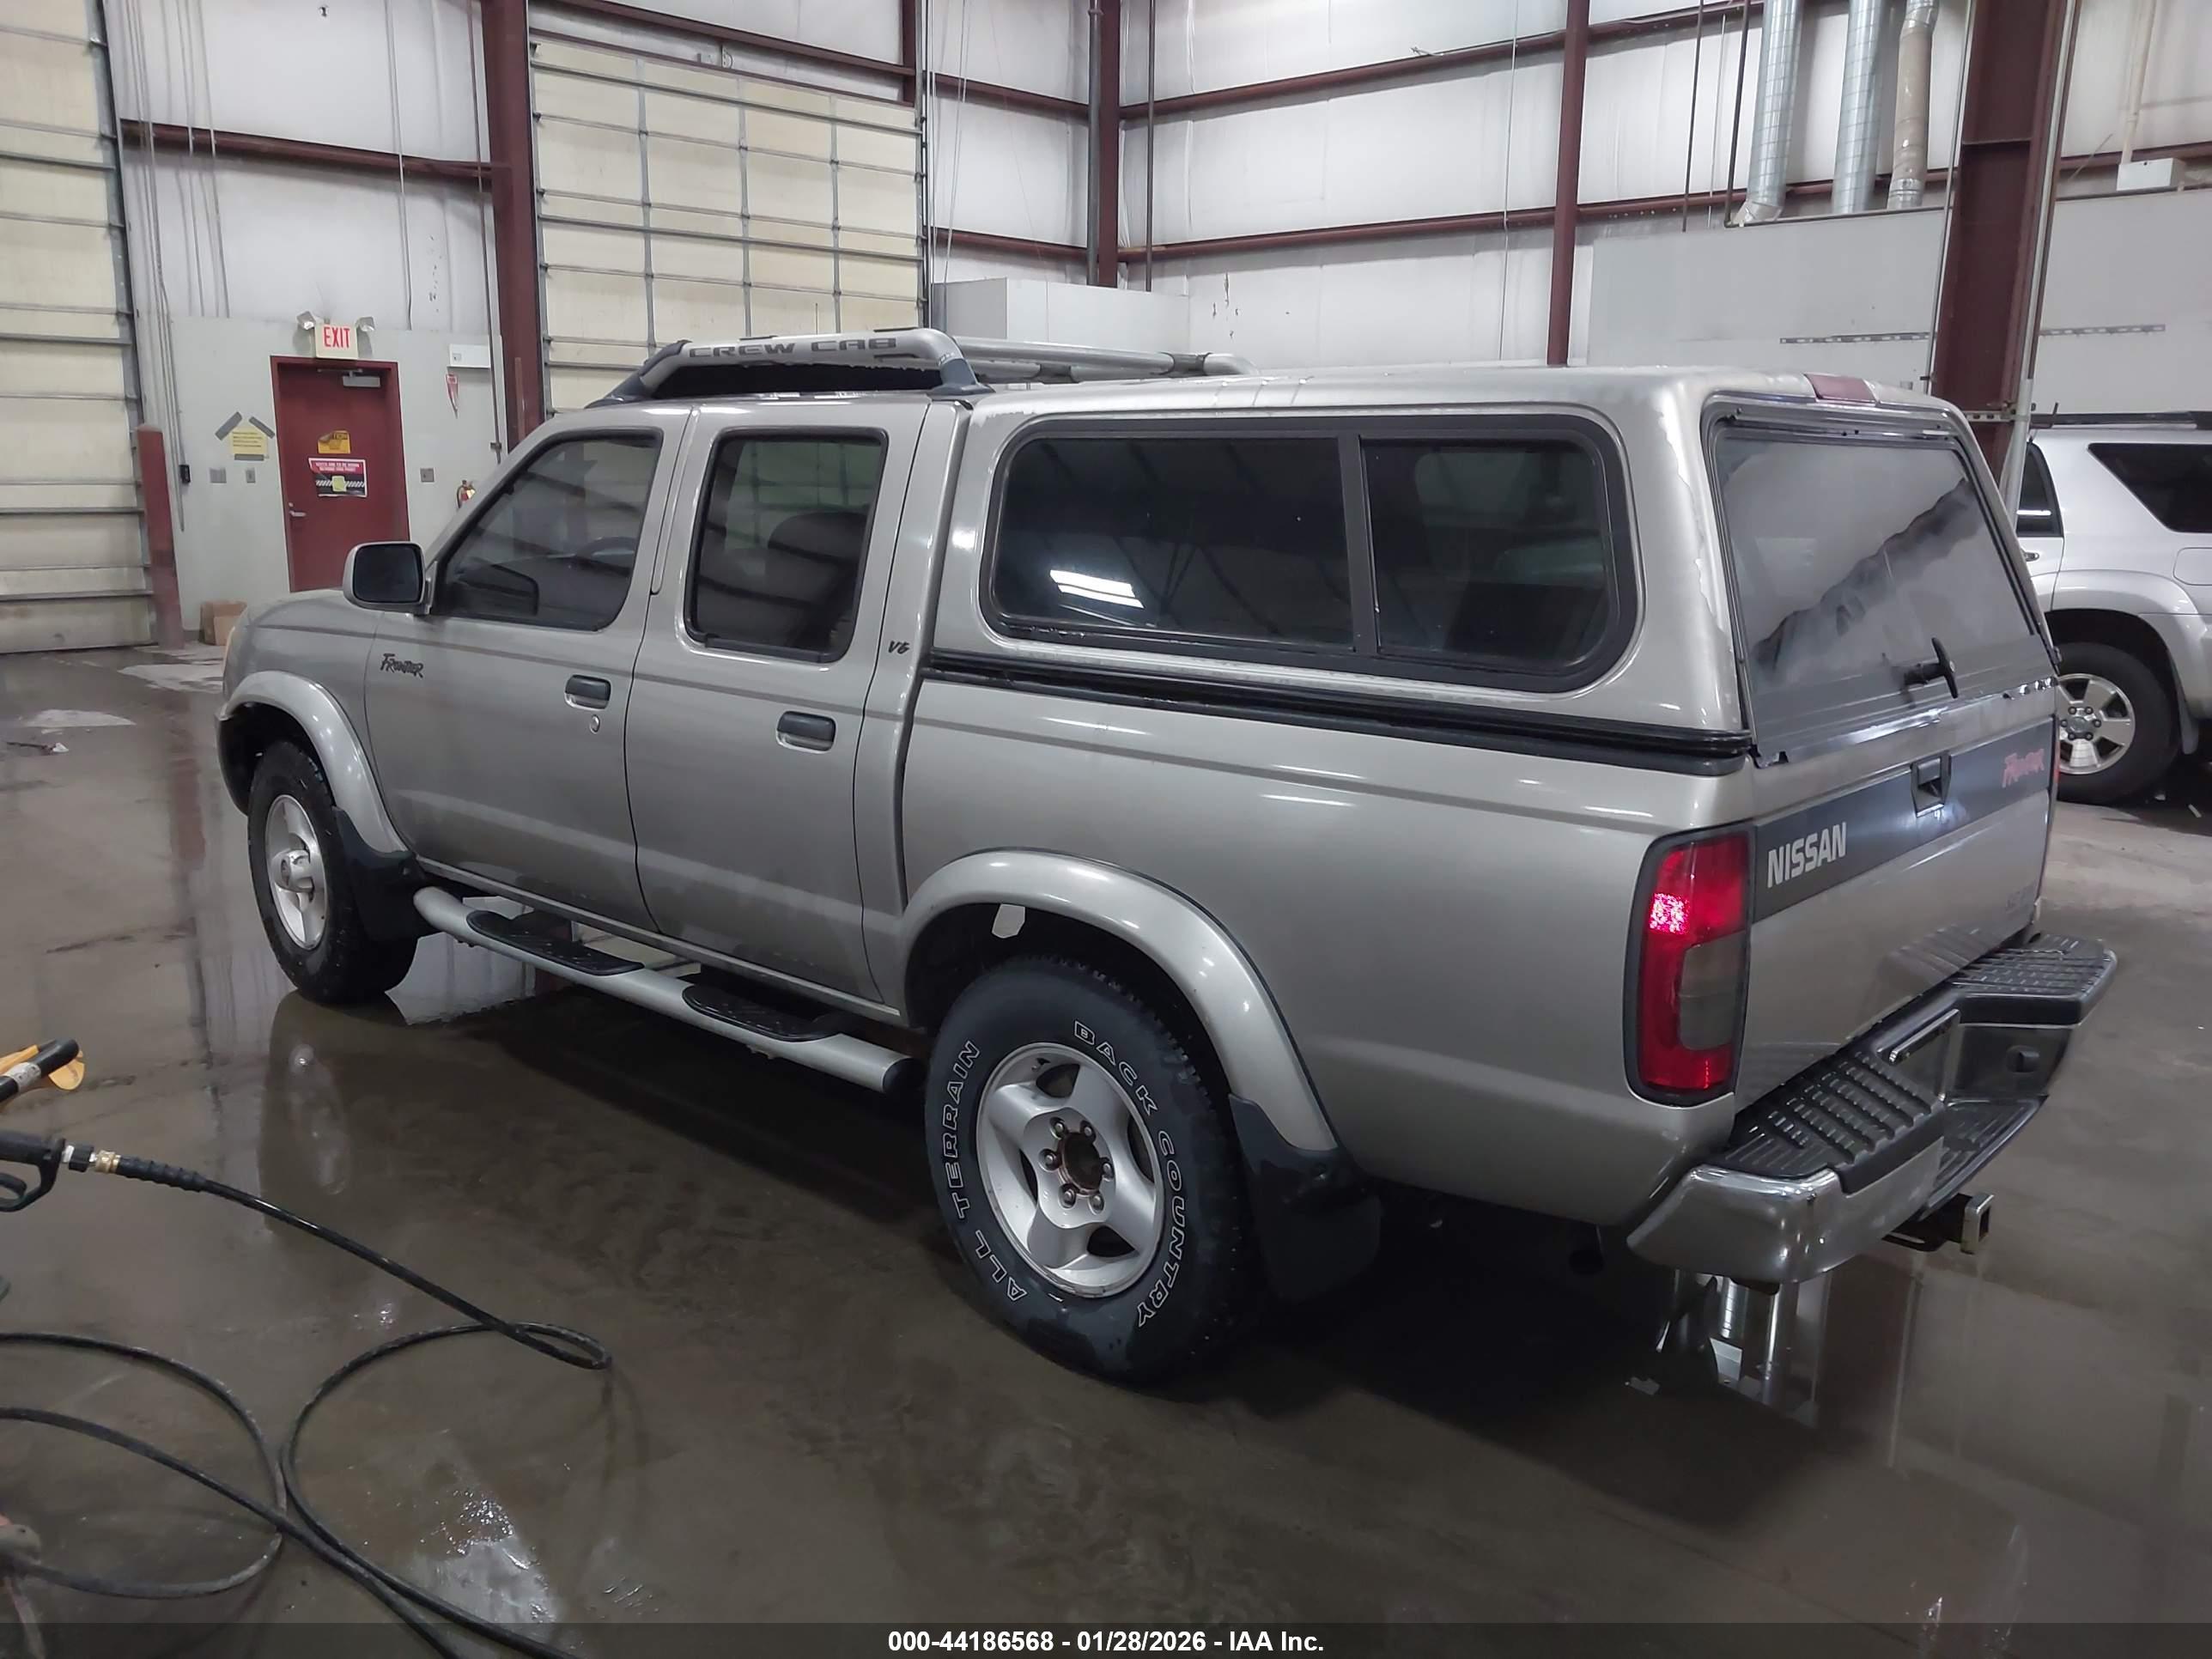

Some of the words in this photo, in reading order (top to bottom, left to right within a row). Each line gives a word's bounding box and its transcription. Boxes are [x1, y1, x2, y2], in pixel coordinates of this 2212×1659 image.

[323, 326, 350, 349] EXIT
[689, 342, 796, 358] CREW
[811, 337, 897, 354] CAB
[888, 640, 910, 654] V6
[1766, 821, 1847, 890] NISSAN
[941, 1039, 981, 1220] TERRAIN
[1073, 1019, 1158, 1117] BACK
[1136, 1129, 1187, 1328] COUNTRY
[975, 1229, 1027, 1303] ALL
